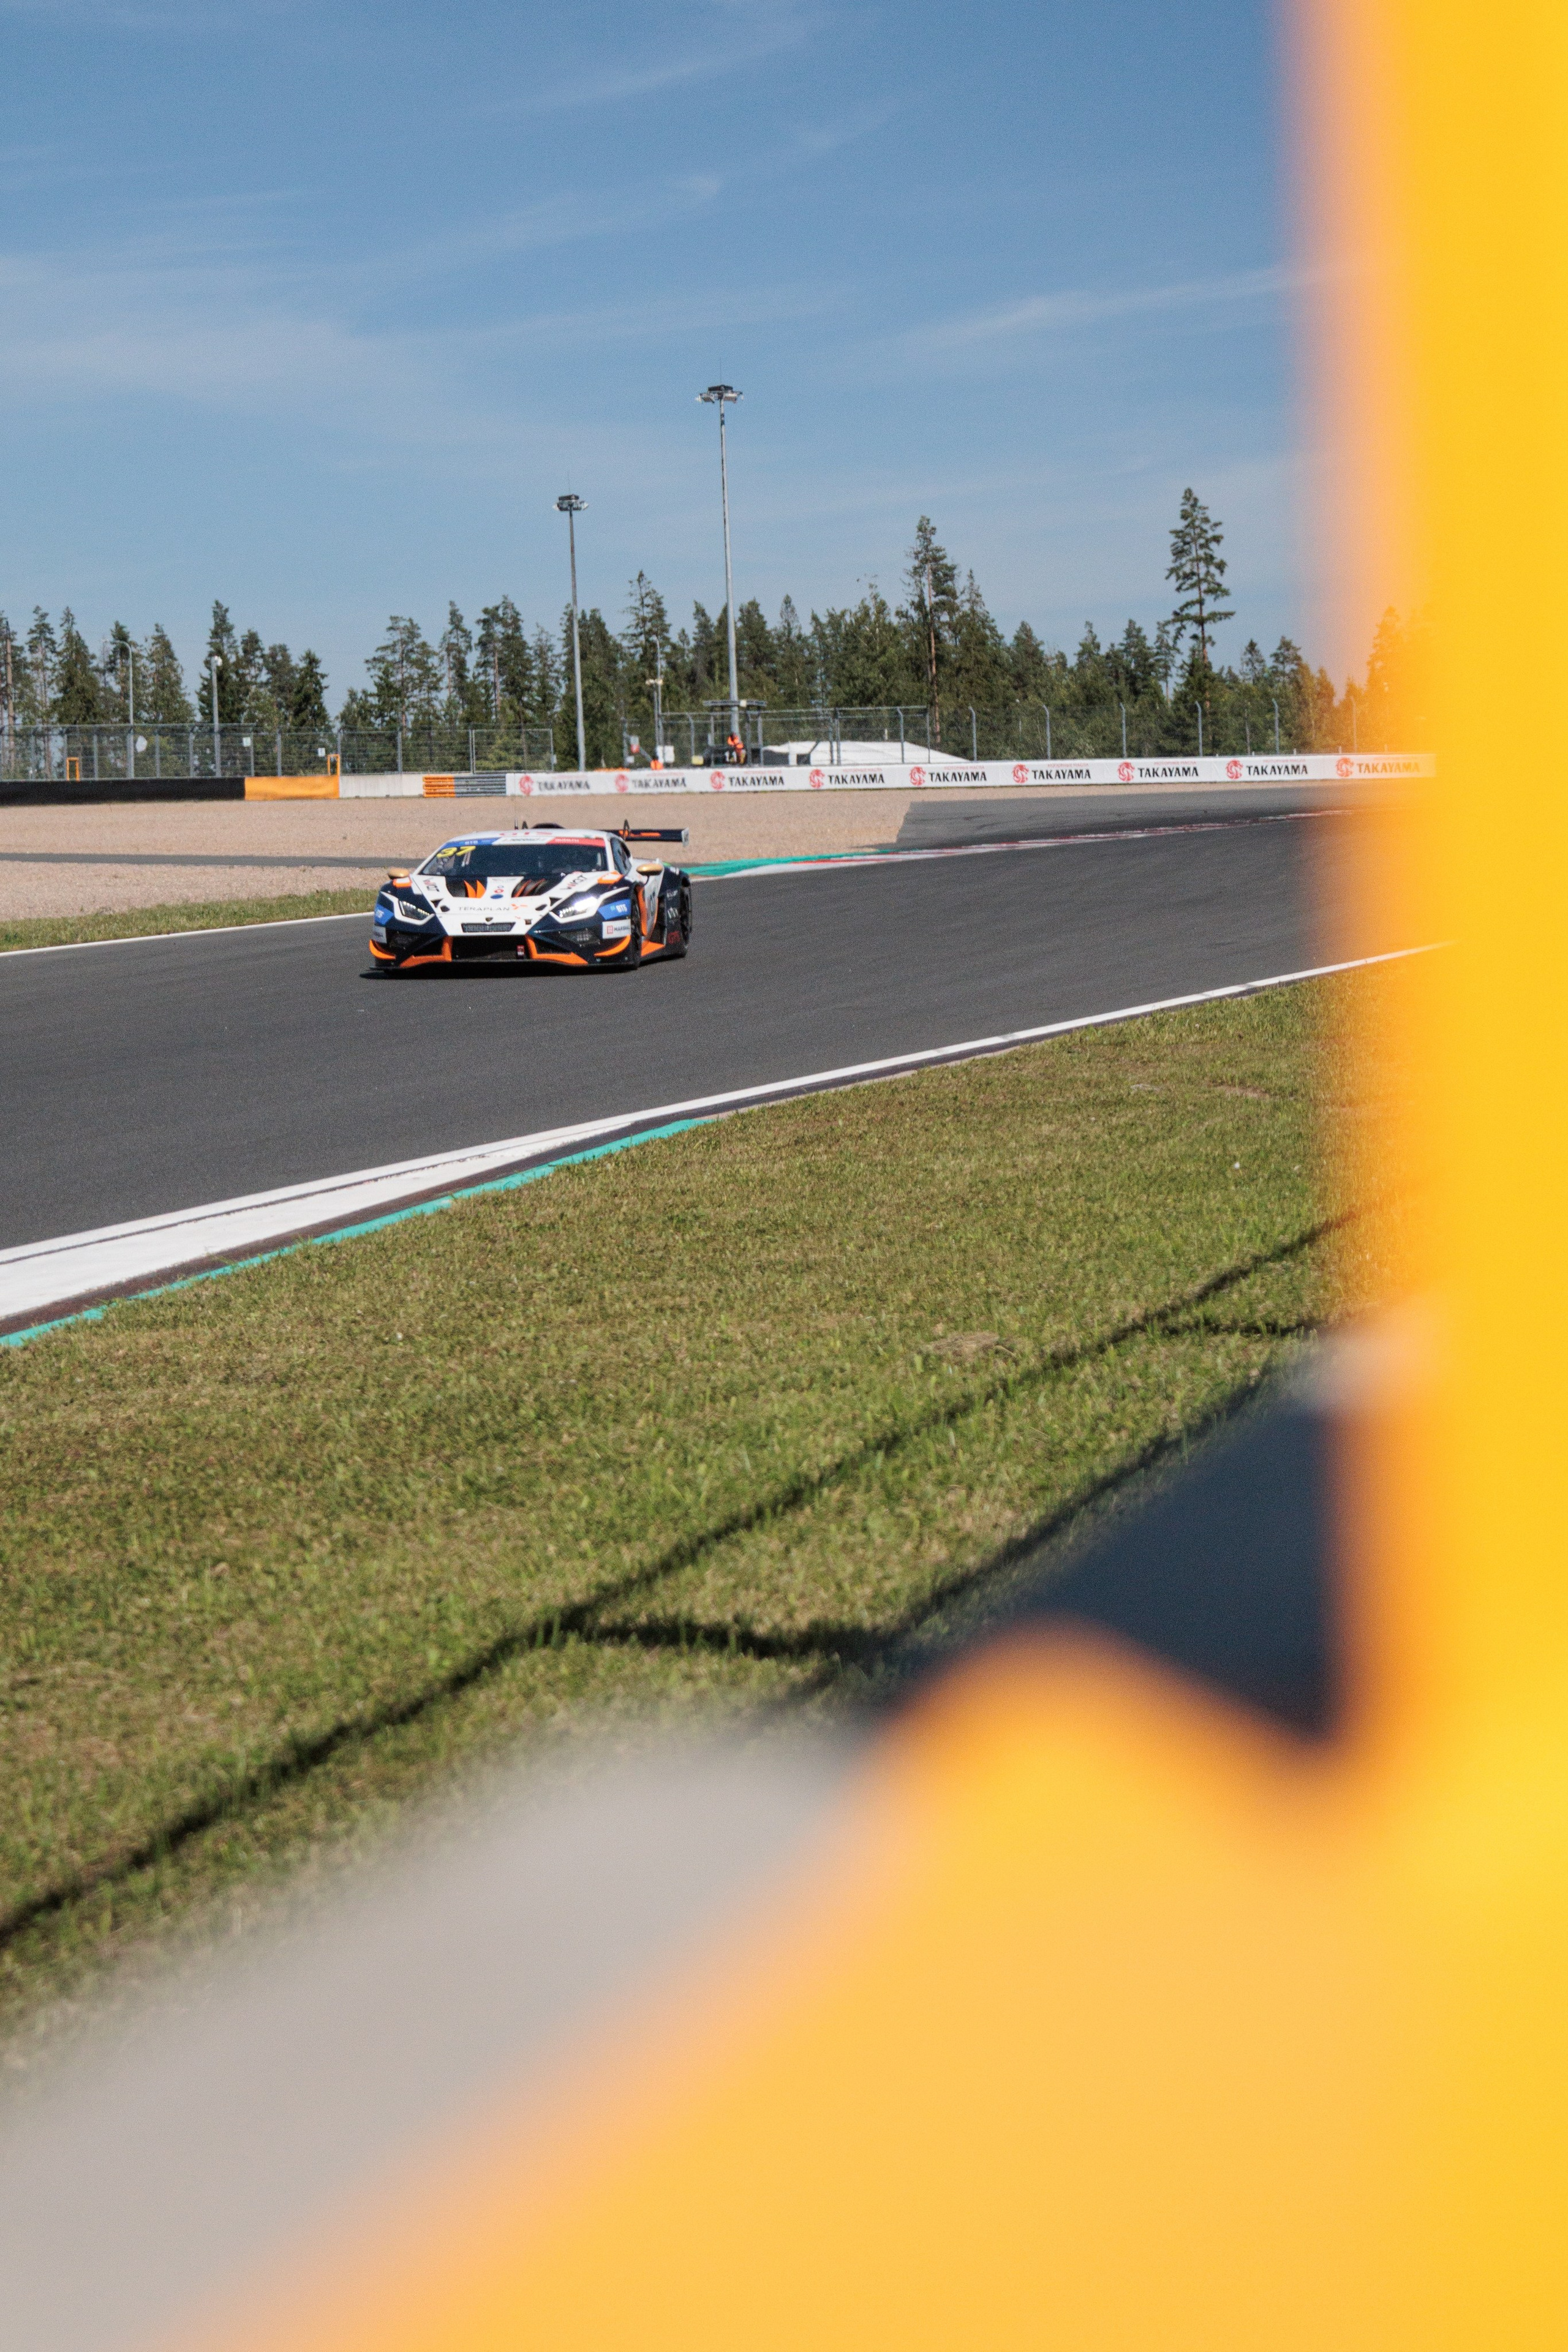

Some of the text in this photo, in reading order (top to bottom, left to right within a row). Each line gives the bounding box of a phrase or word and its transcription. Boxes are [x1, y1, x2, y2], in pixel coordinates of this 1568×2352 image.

[1137, 766, 1199, 778] TAKAYAMA
[1246, 764, 1308, 775] TAKAYAMA
[1357, 762, 1421, 774] TAKAYAMA
[827, 773, 884, 784] TAKAYAMA
[928, 771, 987, 782] TAKAYAMA
[1031, 769, 1091, 780] TAKAYAMA
[632, 777, 687, 788] TAKAYAMA
[728, 775, 784, 786] TAKAYAMA
[437, 846, 476, 858] 37
